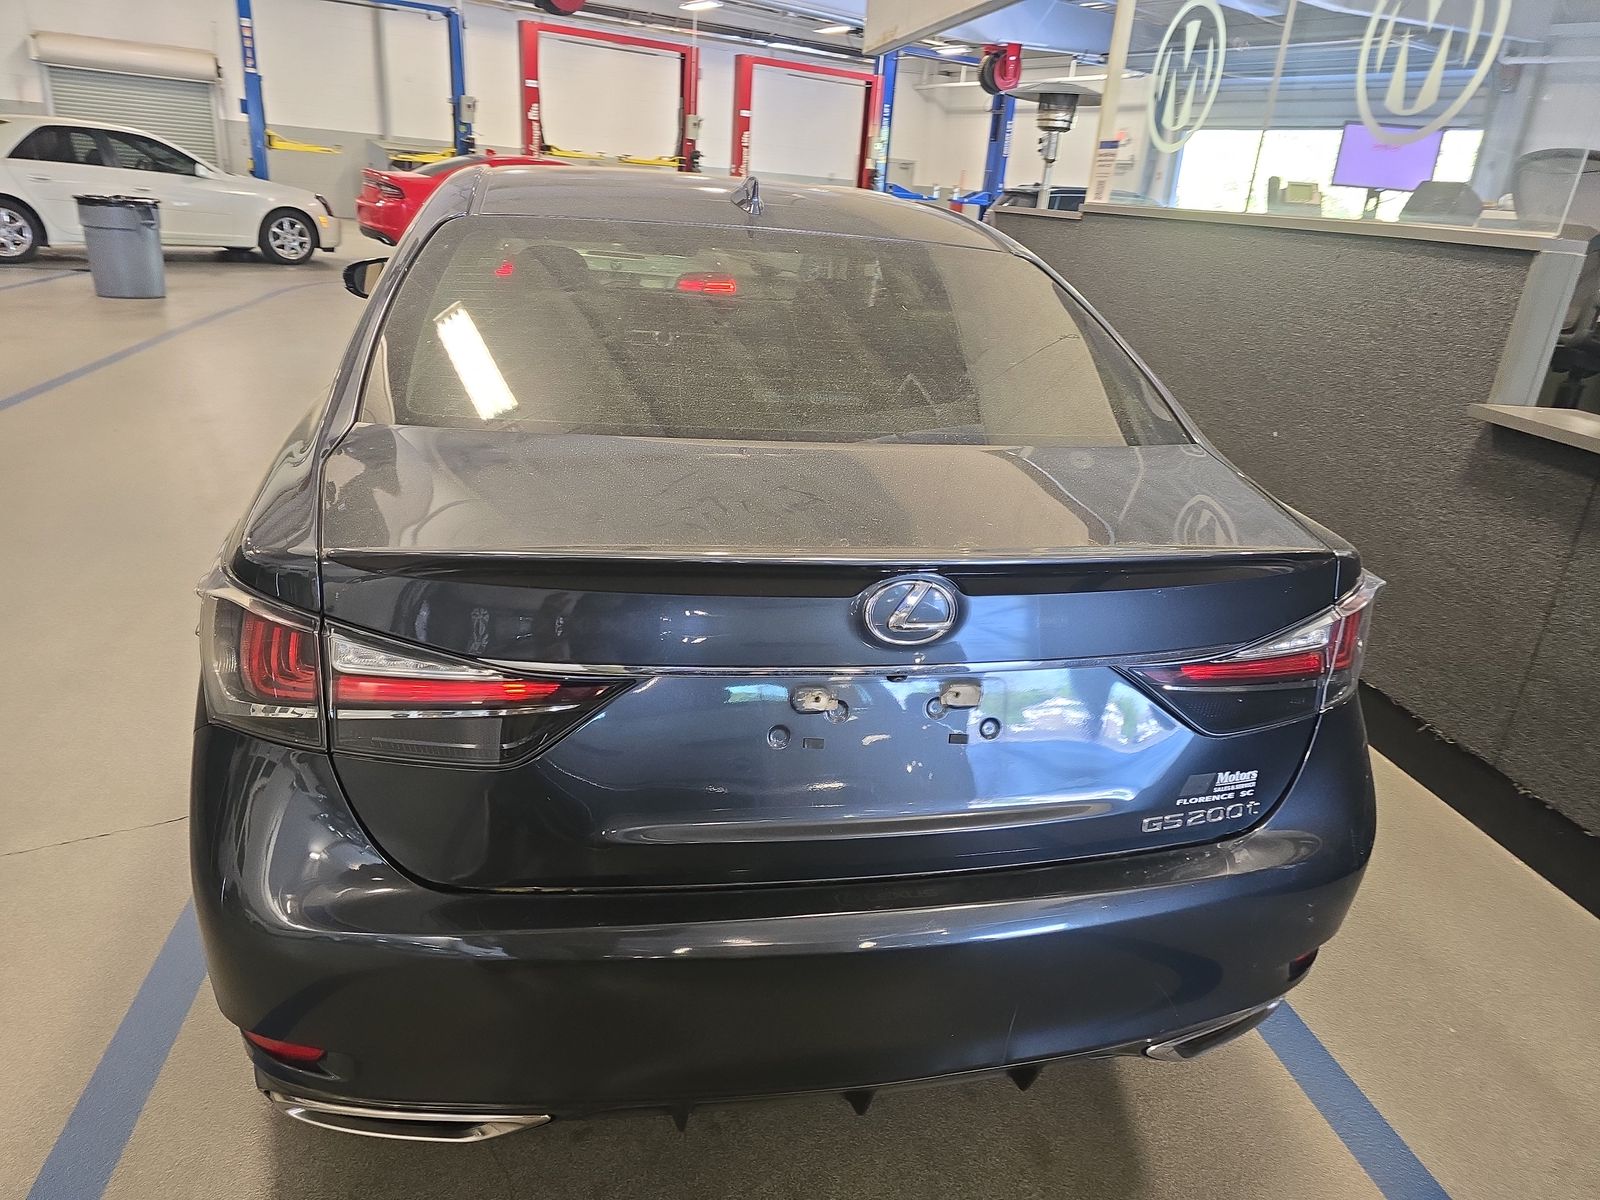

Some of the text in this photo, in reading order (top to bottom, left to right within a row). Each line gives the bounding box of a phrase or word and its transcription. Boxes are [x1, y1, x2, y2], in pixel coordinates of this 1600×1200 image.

[1216, 770, 1258, 784] Motors
[1176, 789, 1255, 806] FLORENCE SC
